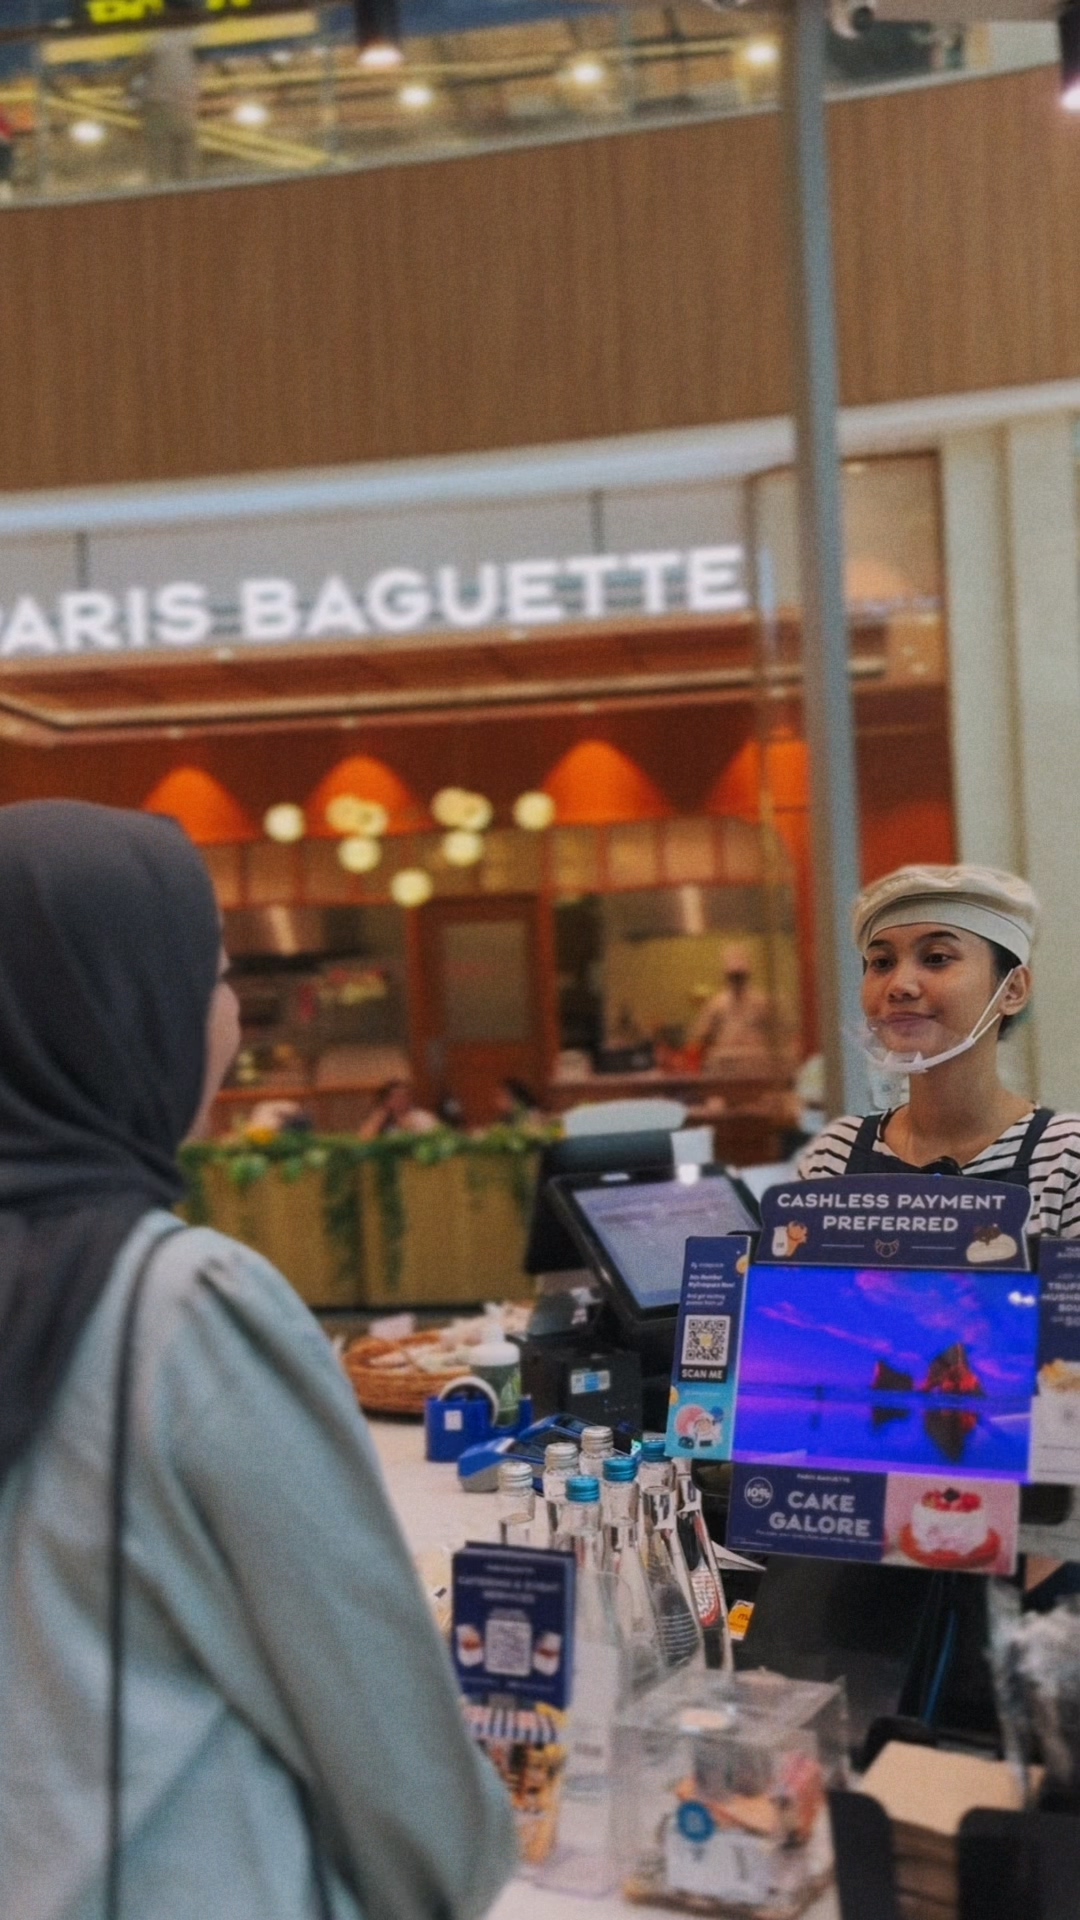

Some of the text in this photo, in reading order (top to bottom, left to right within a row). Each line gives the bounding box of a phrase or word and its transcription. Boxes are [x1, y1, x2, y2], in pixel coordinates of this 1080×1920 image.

[0, 545, 747, 656] ARIS BAGUETTE
[777, 1193, 1006, 1210] CASHLESS PAYMENT
[823, 1215, 959, 1232] PREFERRED
[682, 1368, 723, 1379] SCAN ME
[747, 1487, 770, 1498] 10%
[788, 1490, 856, 1513] CAKE
[769, 1511, 871, 1537] GALORE
